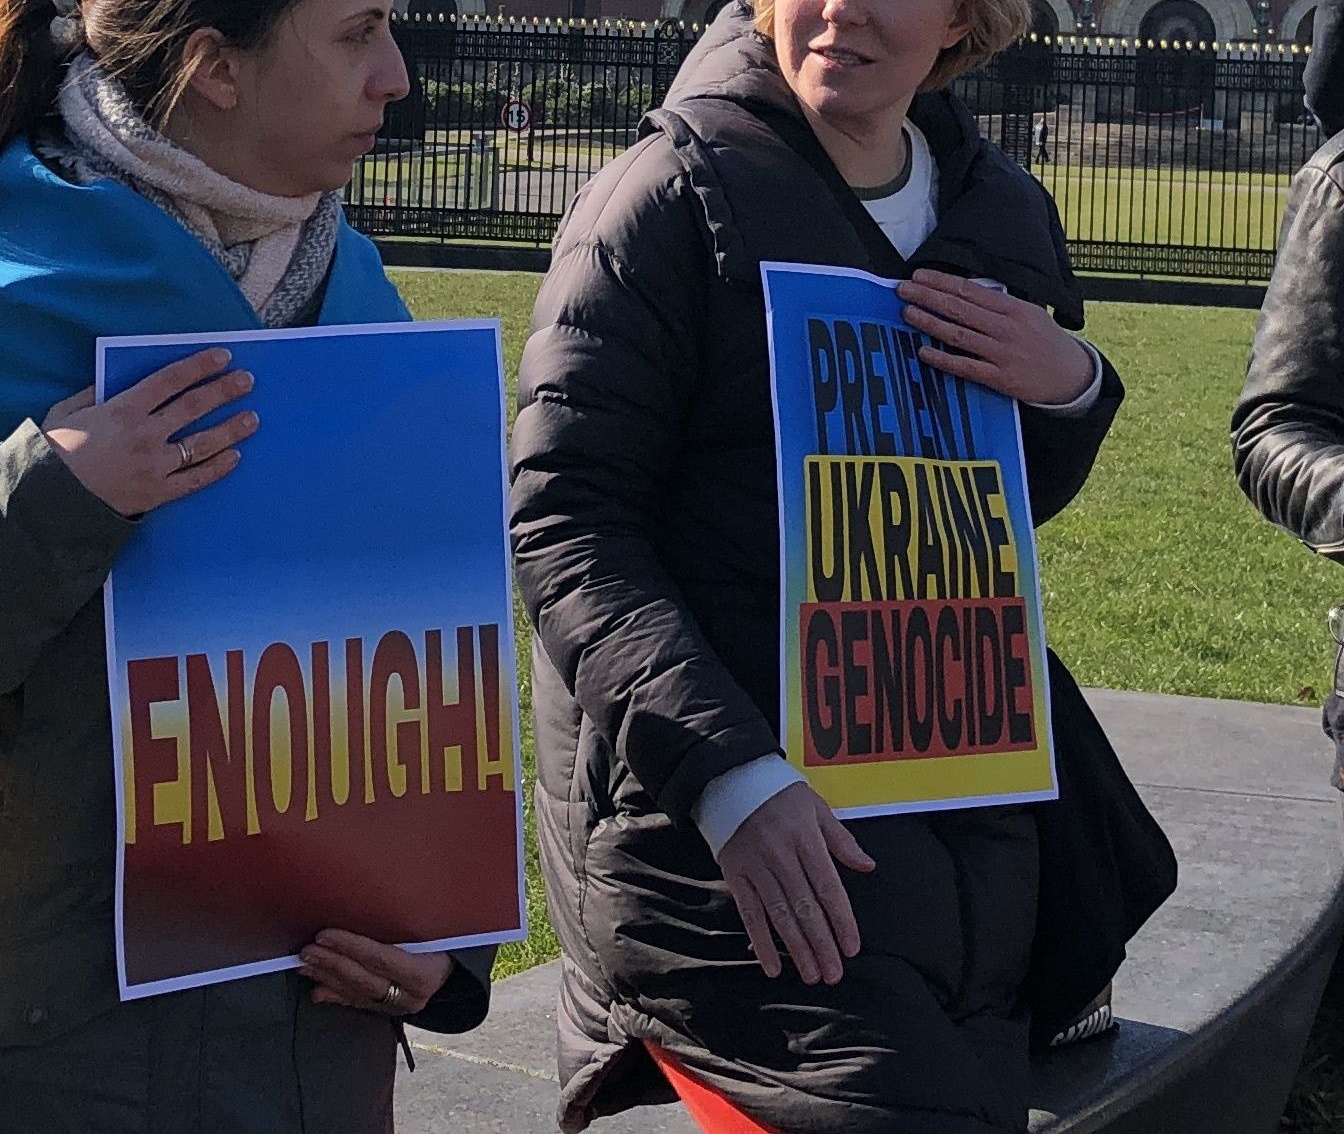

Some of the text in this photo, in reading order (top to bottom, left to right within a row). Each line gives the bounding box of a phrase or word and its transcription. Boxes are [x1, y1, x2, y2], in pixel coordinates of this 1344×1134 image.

[808, 461, 1016, 603] UKRAINE
[126, 623, 515, 845] ENOUGH!
[805, 606, 1032, 760] GENOCIDE
